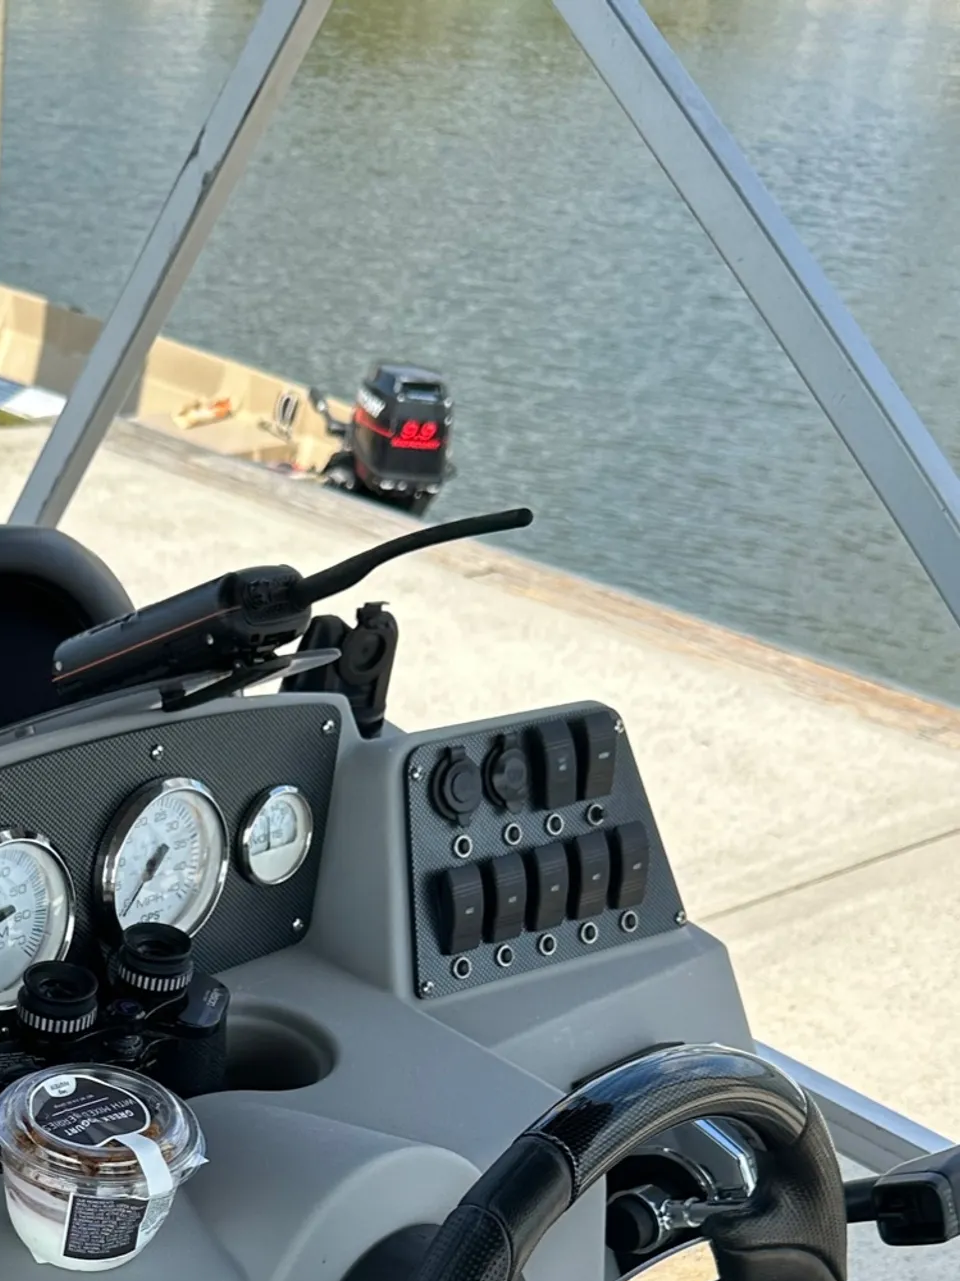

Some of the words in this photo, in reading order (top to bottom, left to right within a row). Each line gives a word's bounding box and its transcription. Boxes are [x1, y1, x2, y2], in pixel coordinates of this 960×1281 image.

[9, 884, 27, 897] 50
[14, 909, 31, 923] 60
[104, 1109, 135, 1122] GREEK
